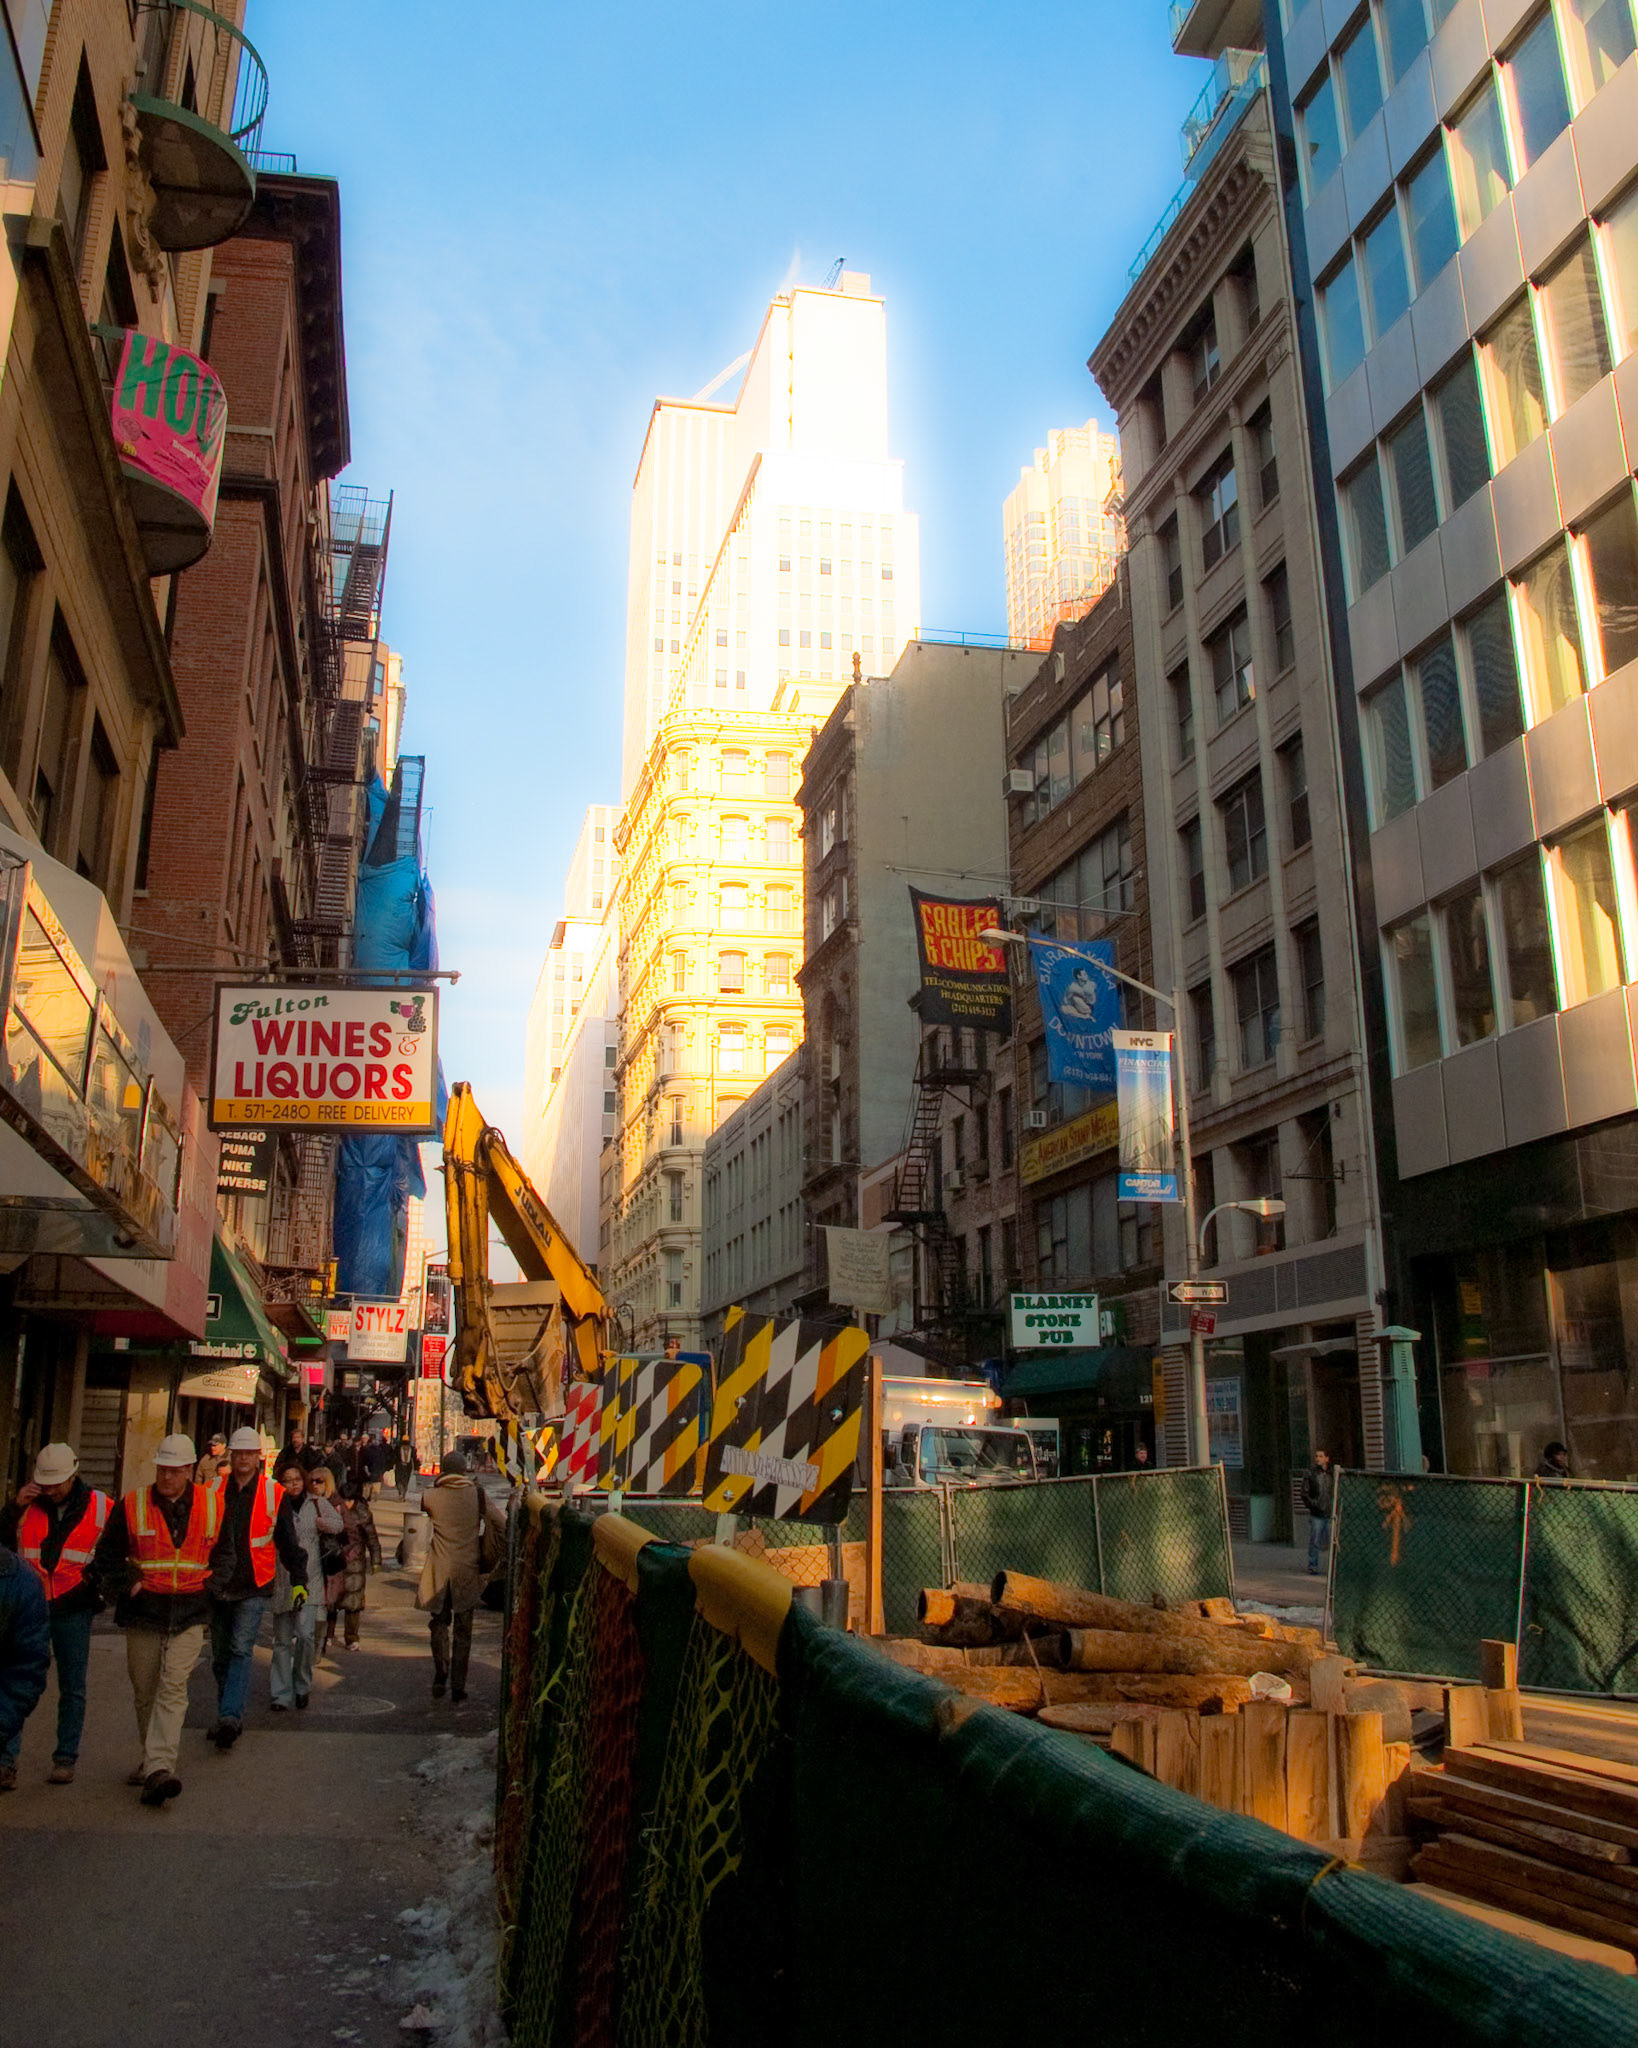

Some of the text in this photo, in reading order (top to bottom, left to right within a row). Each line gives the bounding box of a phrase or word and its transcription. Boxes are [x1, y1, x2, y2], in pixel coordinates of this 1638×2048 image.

[920, 904, 998, 938] CABLES
[940, 938, 997, 970] CHIPS
[229, 995, 330, 1026] Fulton
[252, 1019, 420, 1059] WINES &
[1129, 1037, 1154, 1047] NYC
[234, 1061, 414, 1100] LIQUORS
[227, 1104, 415, 1121] T. 571-2480 FREE DELIVERY
[221, 1143, 256, 1156] PUMA
[222, 1160, 253, 1173] NIKE
[1177, 1288, 1219, 1297] ONE WAY
[1014, 1296, 1095, 1309] BLARNEY
[355, 1306, 405, 1333] STYLZ
[1025, 1314, 1081, 1327] STONE
[1039, 1330, 1074, 1344] PUB
[189, 1340, 243, 1357] Timberland
[203, 1376, 235, 1389] Corner
[1139, 1395, 1152, 1404] 121
